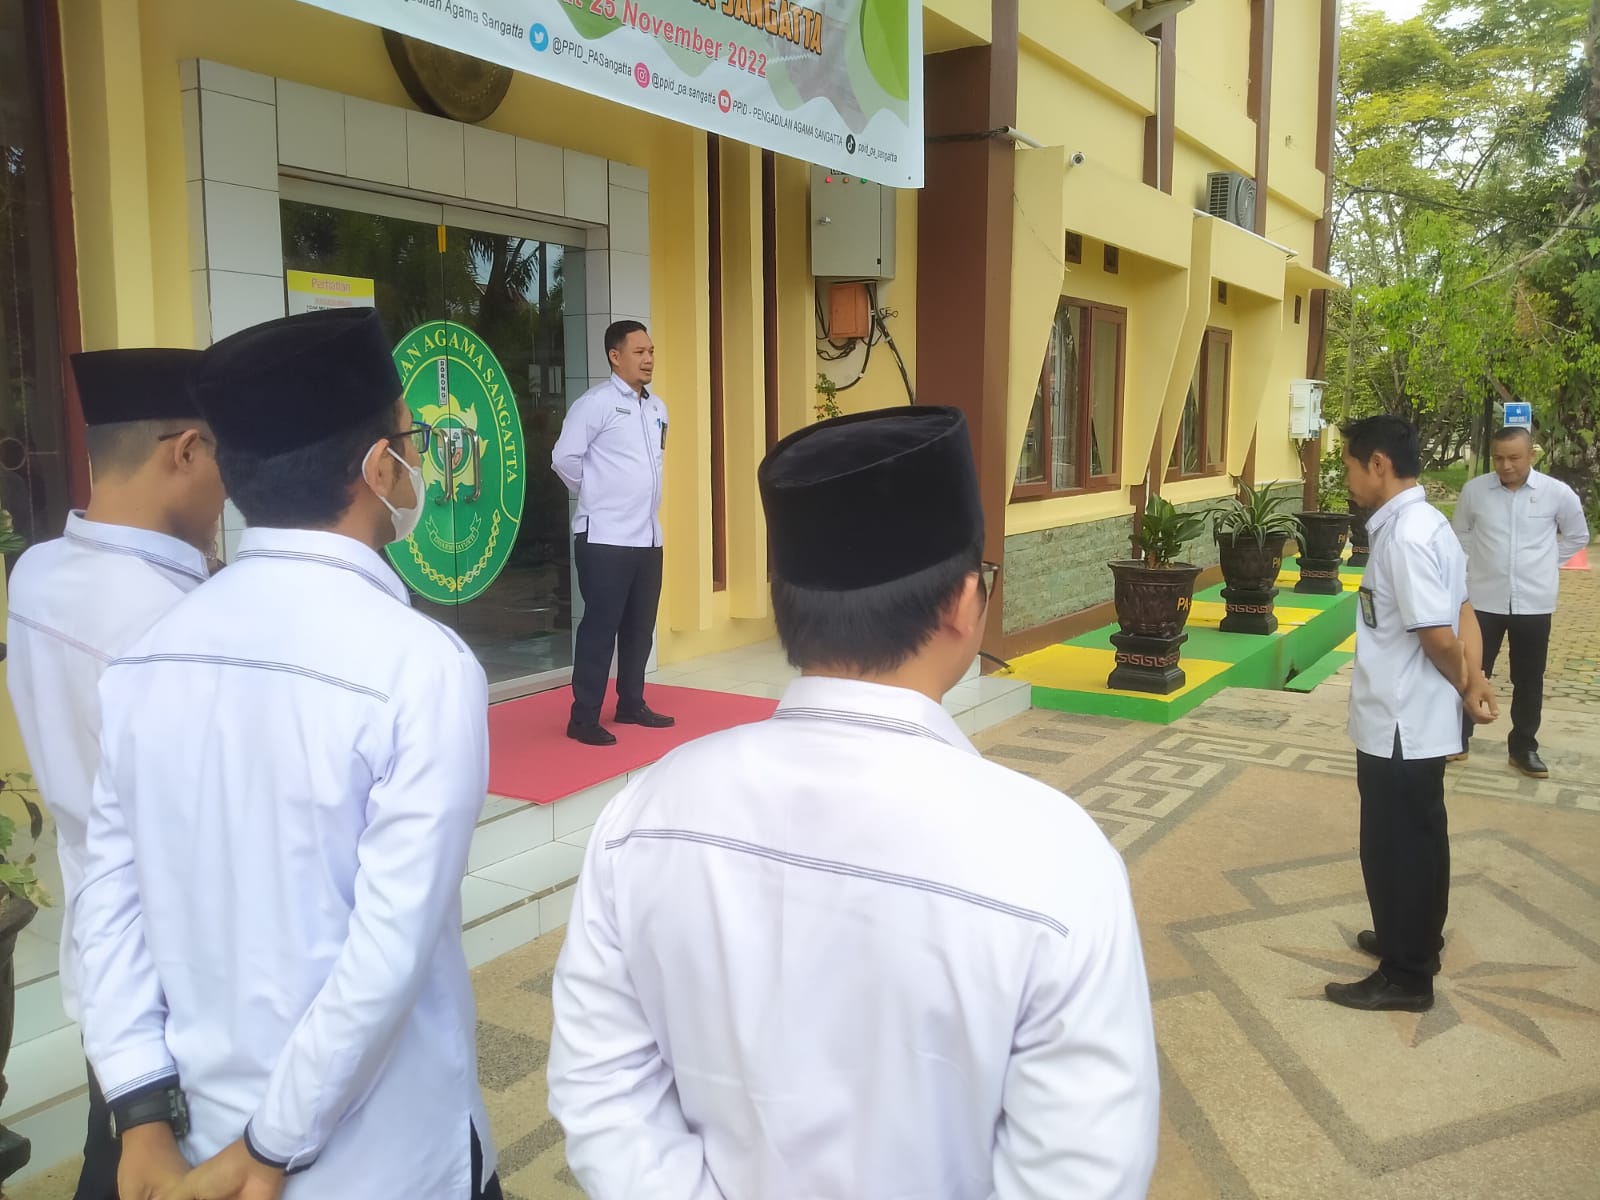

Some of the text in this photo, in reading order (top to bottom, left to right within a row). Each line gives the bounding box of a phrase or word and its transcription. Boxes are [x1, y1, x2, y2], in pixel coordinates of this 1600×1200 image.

[444, 0, 479, 23] Agama
[481, 12, 524, 39] Sangatta
[622, 0, 722, 60] November
[727, 42, 768, 77] 2022
[552, 37, 632, 76] @PPID_PASangatta
[732, 100, 748, 115] PPID
[753, 106, 793, 131] PENGADILAN
[793, 120, 814, 139] AGAMA
[814, 127, 843, 147] SANGATTA
[424, 329, 484, 371] AGAMA
[483, 368, 519, 484] SANGATTA
